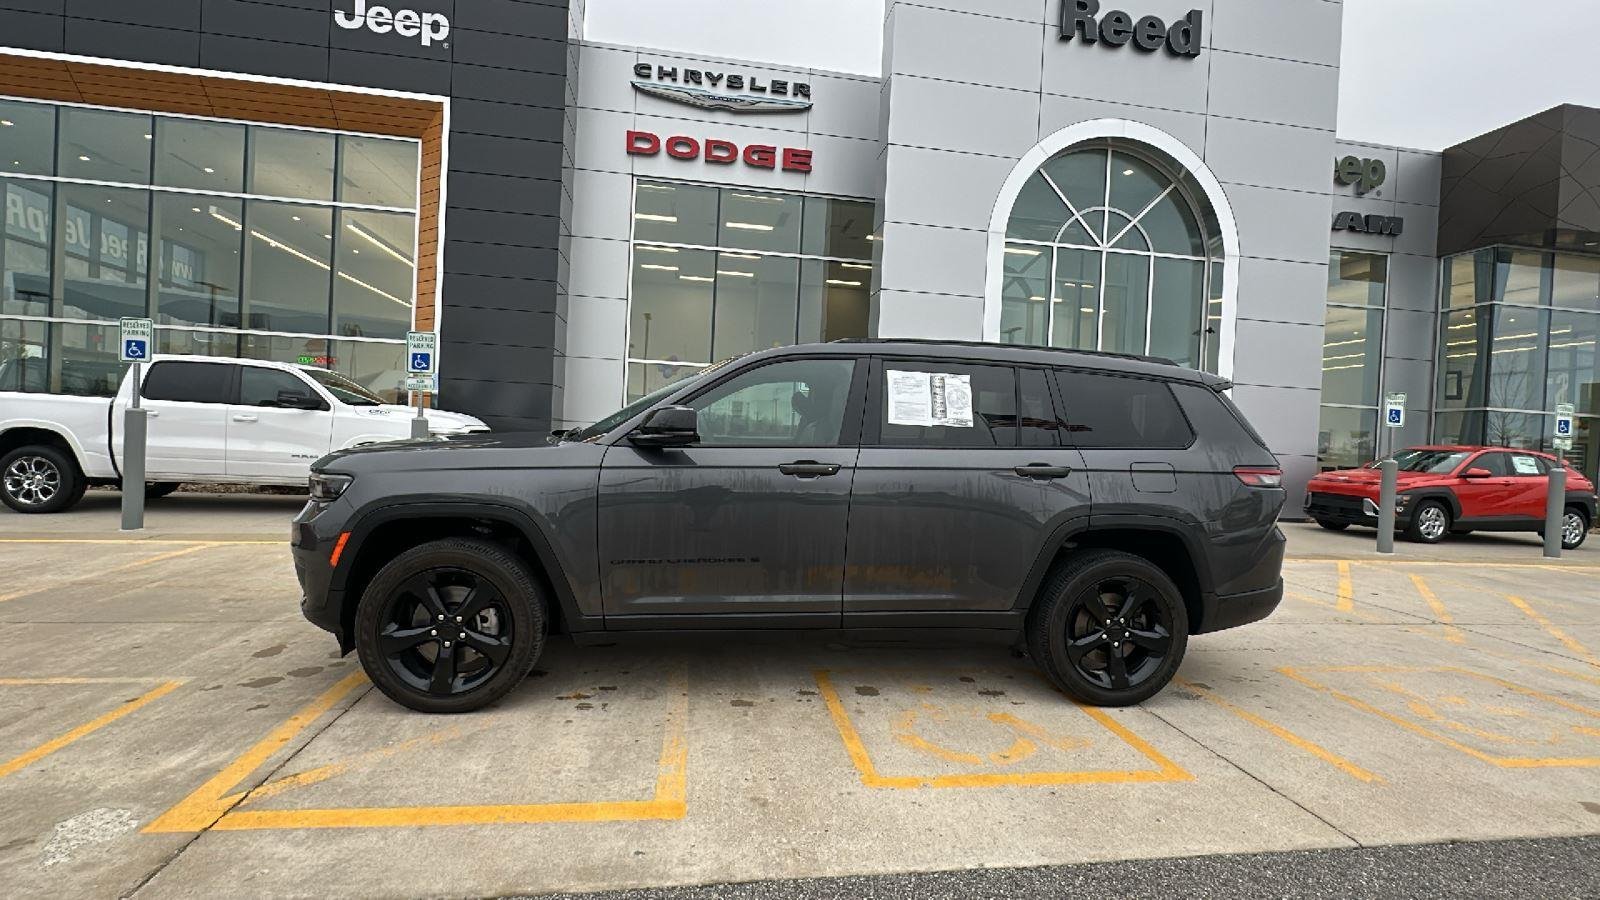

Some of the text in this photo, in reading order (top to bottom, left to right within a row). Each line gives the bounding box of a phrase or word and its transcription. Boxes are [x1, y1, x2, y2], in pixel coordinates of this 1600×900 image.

[334, 0, 450, 47] Jeep
[1060, 0, 1203, 58] Reed
[633, 63, 812, 98] CHRYSLER
[626, 130, 813, 173] DODGE
[1333, 155, 1386, 196] ep
[1331, 211, 1404, 237] AM
[122, 321, 150, 329] RESERVED
